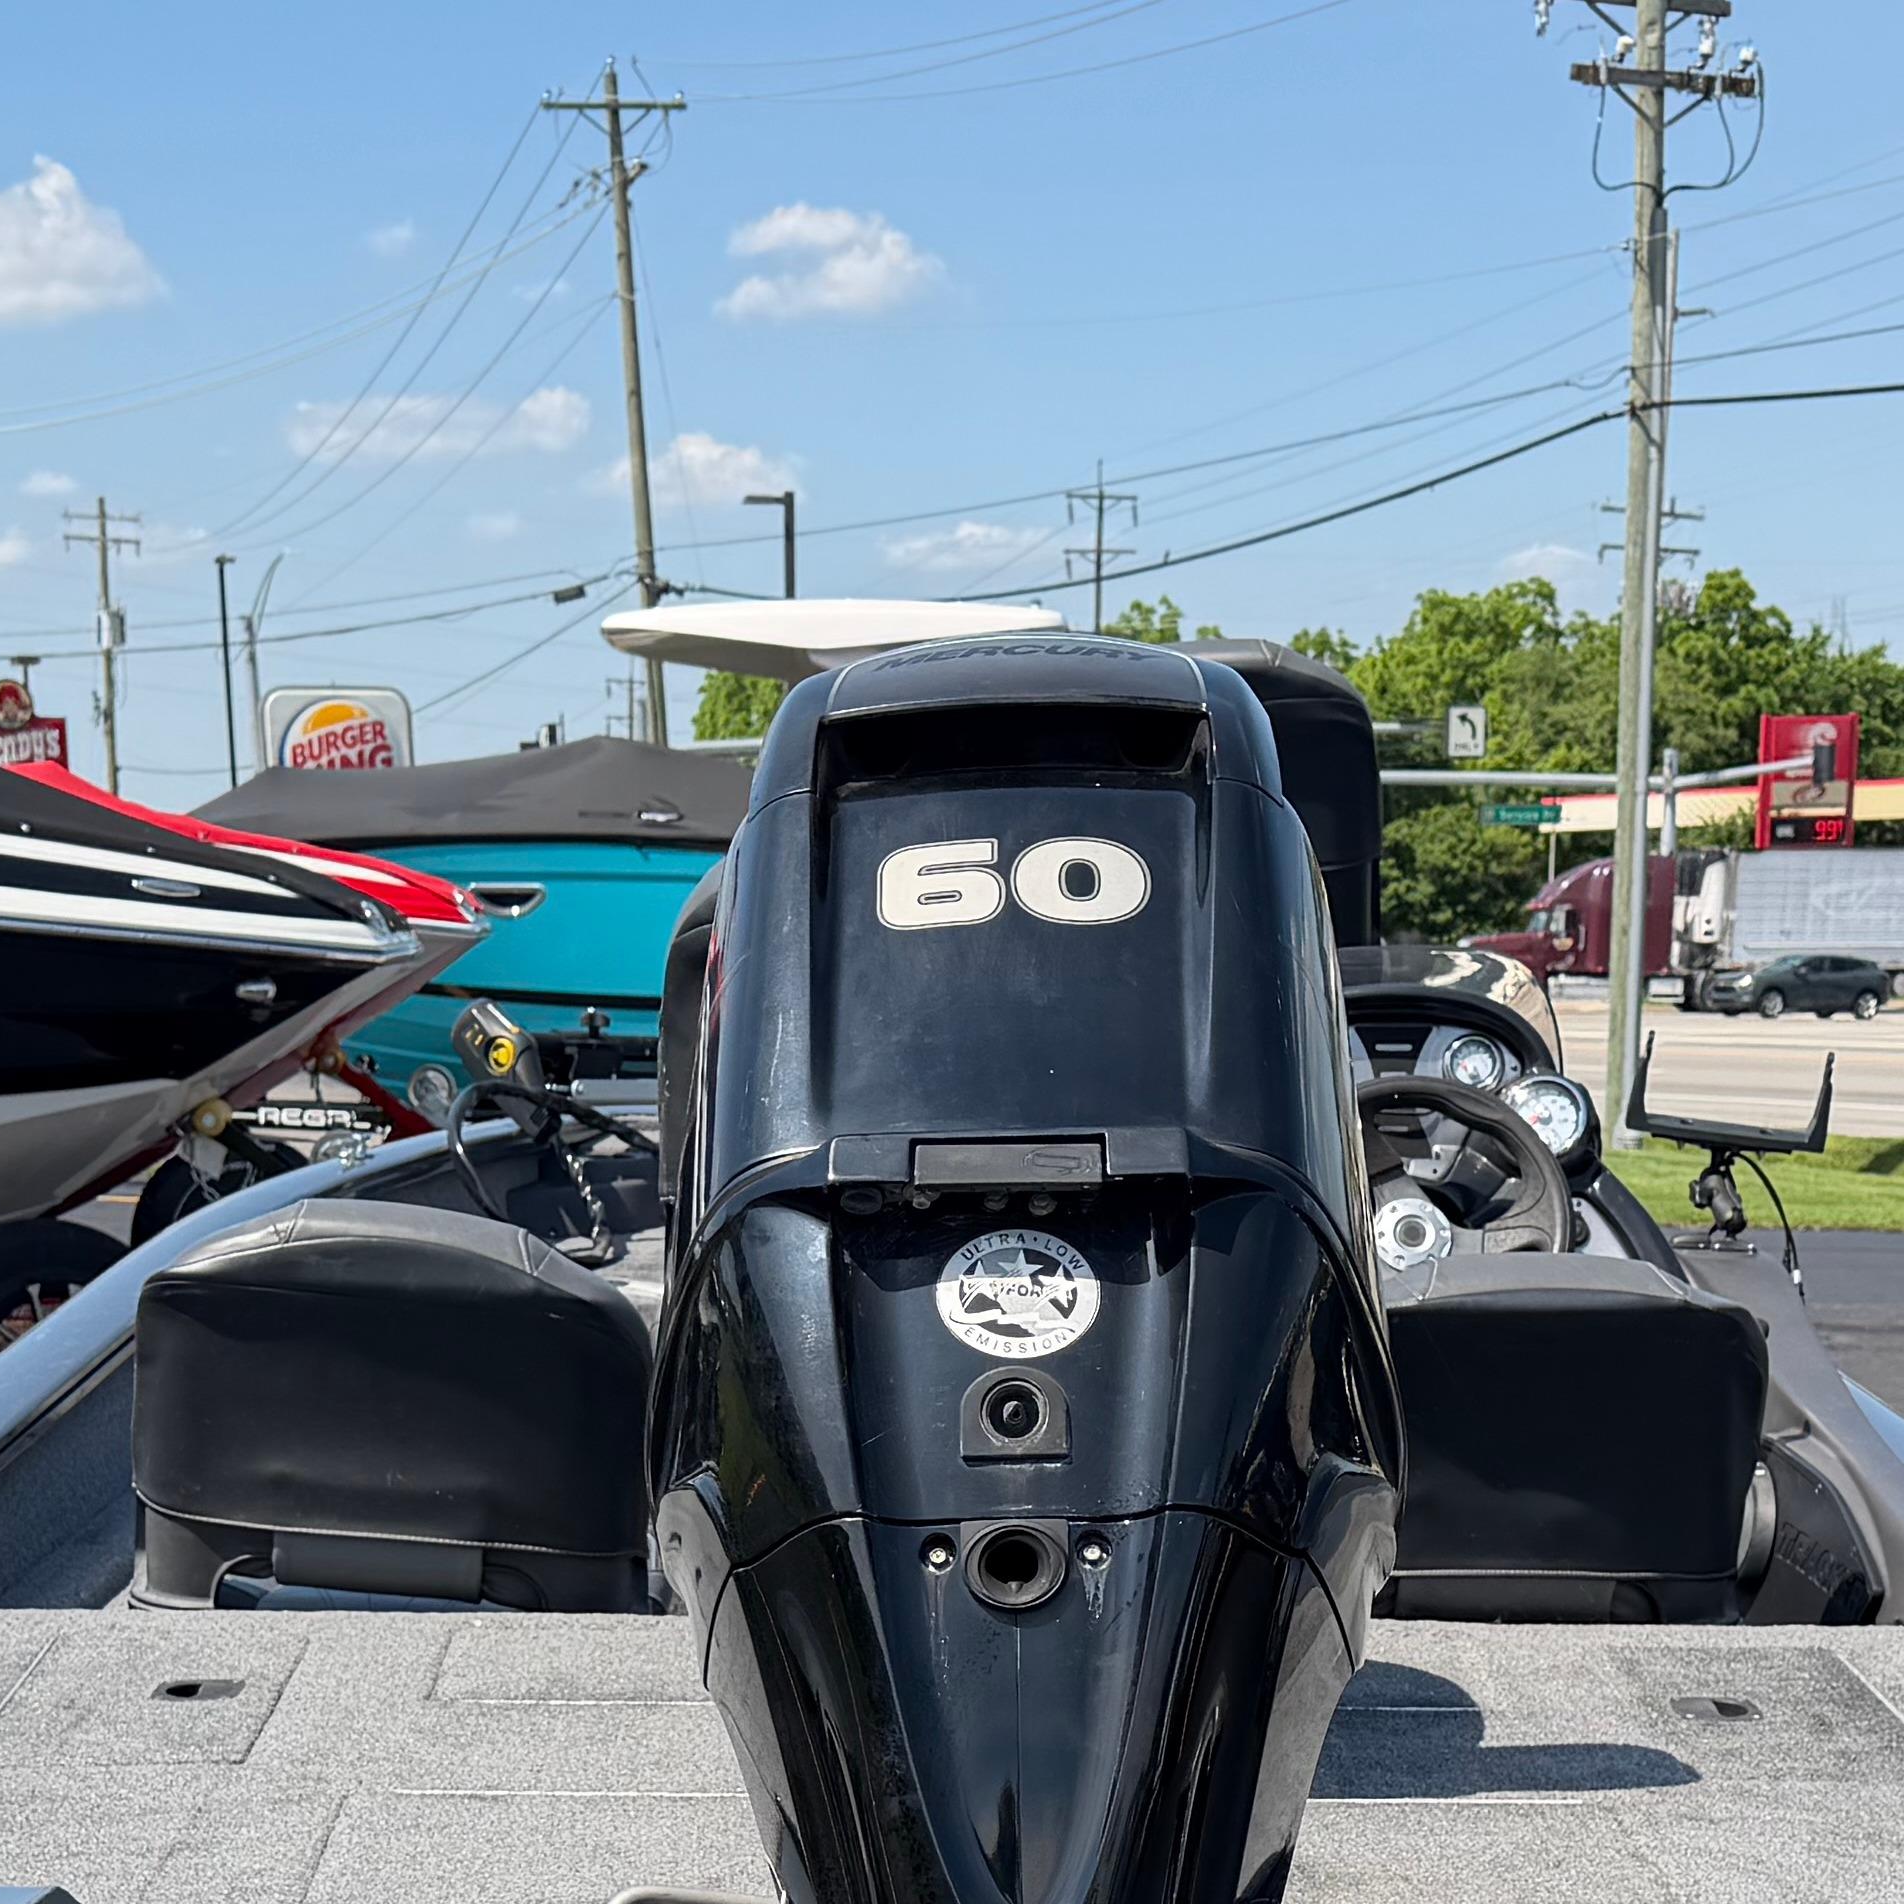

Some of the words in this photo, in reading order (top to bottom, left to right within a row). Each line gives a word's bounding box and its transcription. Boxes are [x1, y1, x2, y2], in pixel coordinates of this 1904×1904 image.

[291, 719, 387, 769] BURGER
[877, 836, 1152, 931] 60
[960, 1232, 1027, 1263] ULTRA
[1044, 1236, 1086, 1272] LOW
[964, 1326, 1068, 1354] EMISSION
